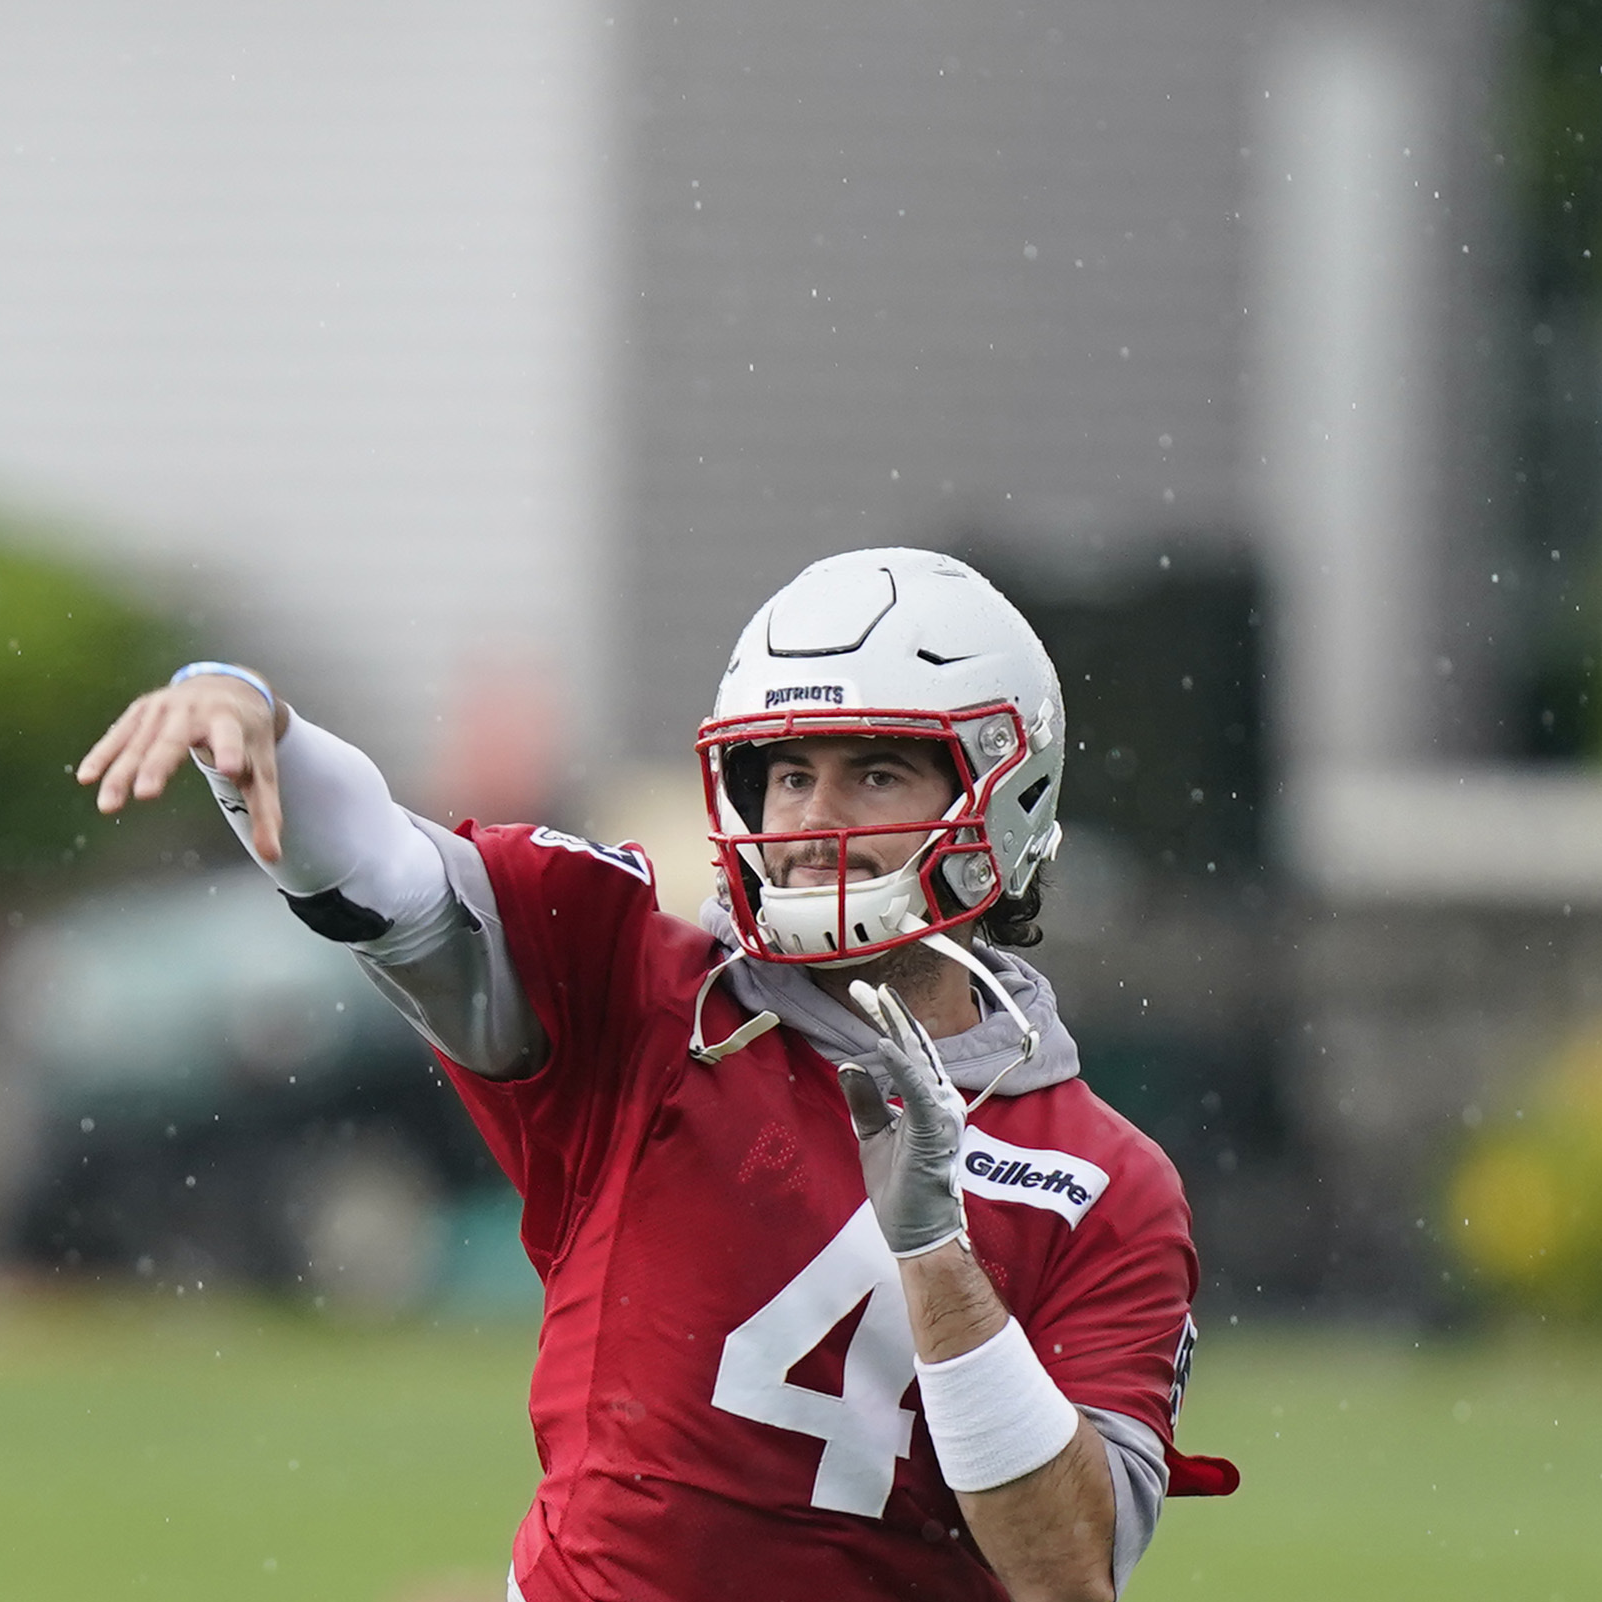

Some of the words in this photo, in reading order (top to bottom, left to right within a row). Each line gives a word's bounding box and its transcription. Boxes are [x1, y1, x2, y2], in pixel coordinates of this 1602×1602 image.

[765, 685, 844, 709] PATRIOTS
[965, 1151, 1088, 1205] Gillette
[711, 1198, 917, 1519] 4
